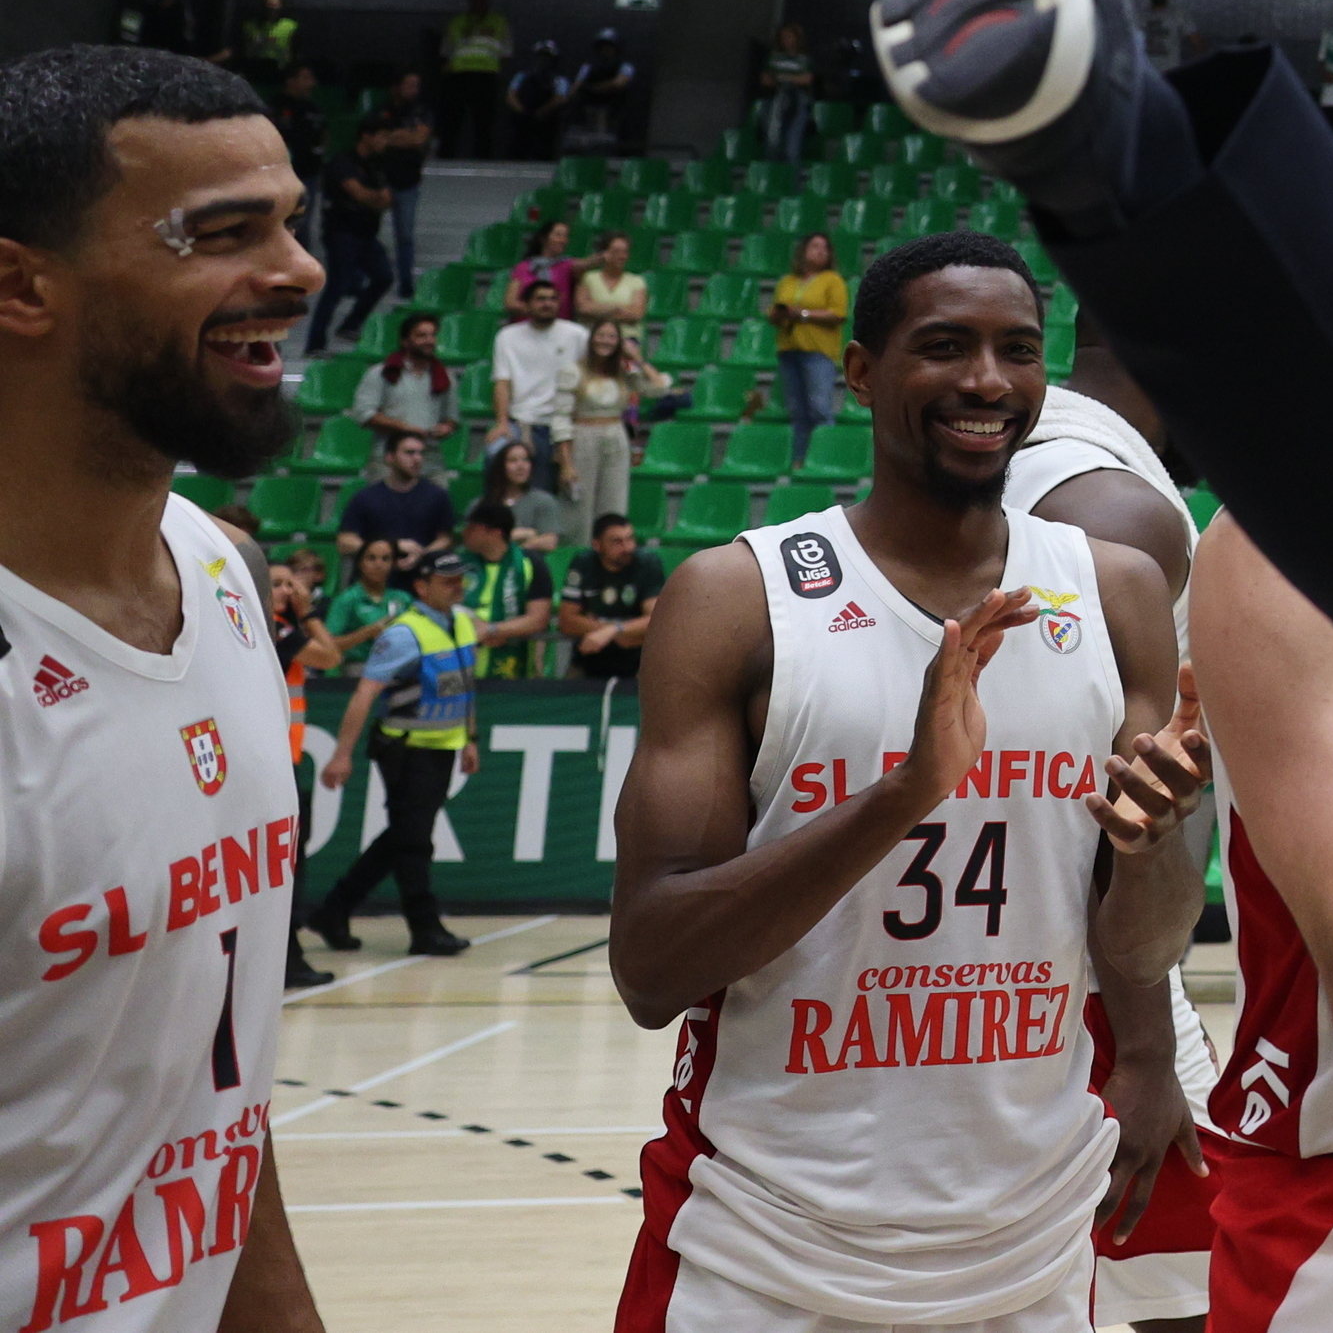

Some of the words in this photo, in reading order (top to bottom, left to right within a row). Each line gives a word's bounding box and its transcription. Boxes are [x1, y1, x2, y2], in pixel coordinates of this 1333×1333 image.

[828, 618, 877, 633] adidas
[791, 758, 856, 814] SL
[882, 750, 1097, 800] NFICA
[882, 820, 1008, 942] 34
[38, 884, 148, 983] SL
[857, 960, 1053, 992] conservas
[210, 926, 241, 1094] 1
[785, 982, 1070, 1075] RAMIREZ
